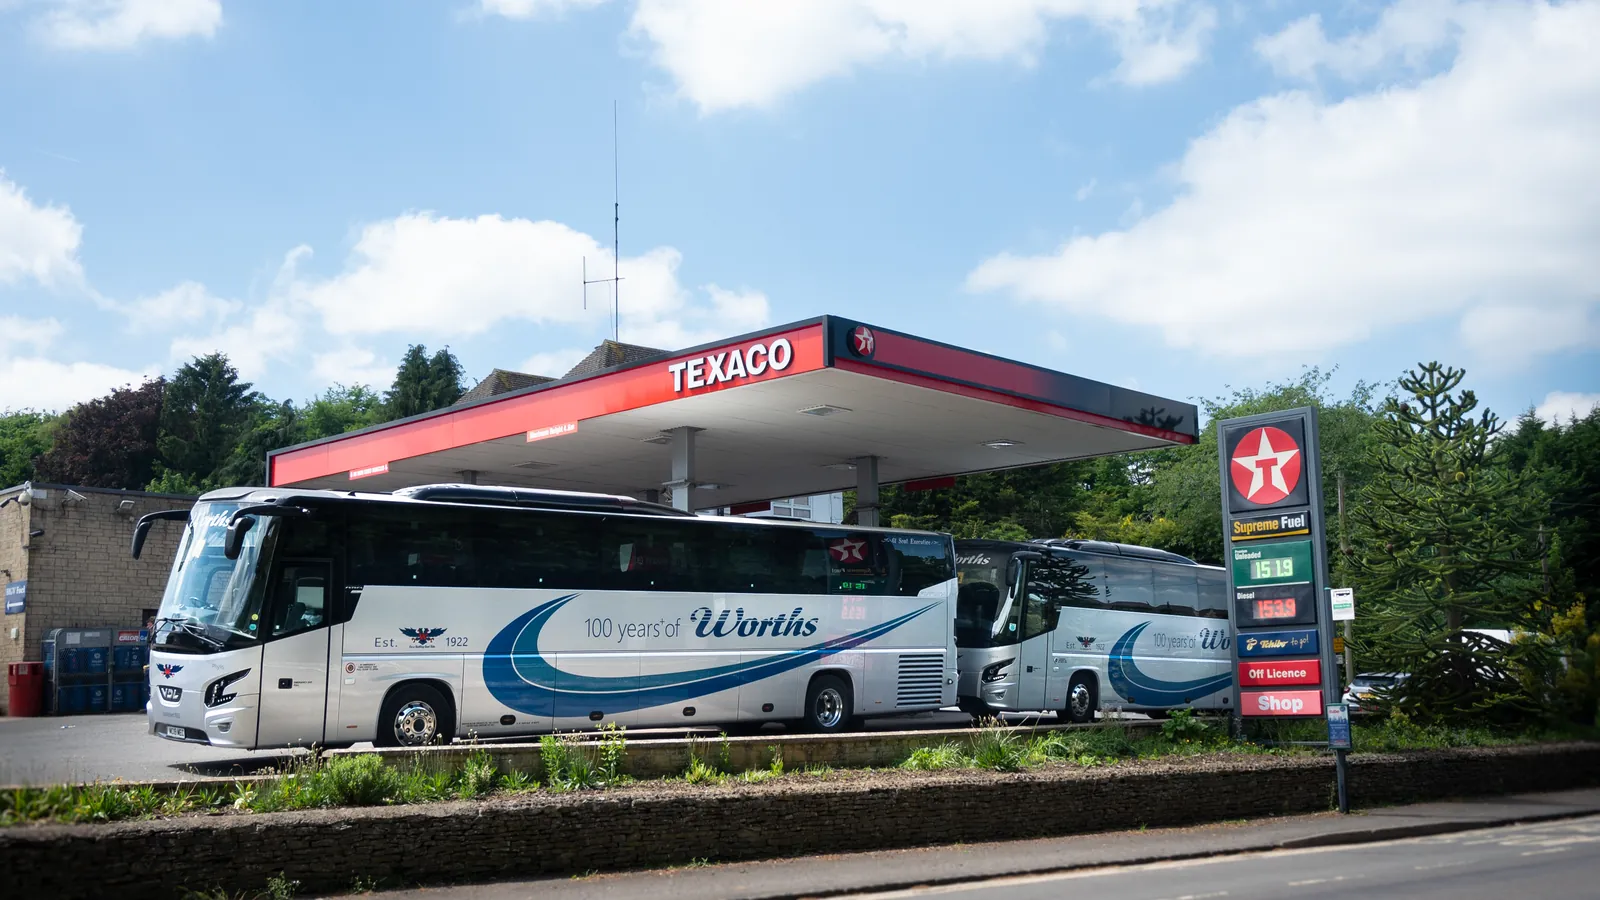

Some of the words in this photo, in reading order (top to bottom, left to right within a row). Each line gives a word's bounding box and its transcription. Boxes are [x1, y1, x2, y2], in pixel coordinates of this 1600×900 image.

[668, 338, 792, 392] TEXACO
[1234, 520, 1279, 534] Supreme
[1281, 514, 1305, 529] Fuel
[956, 553, 991, 565] orths
[1235, 551, 1261, 560] Unleaded
[1237, 592, 1255, 600] Diesel
[585, 617, 612, 637] 100
[665, 617, 681, 637] of
[690, 607, 819, 638] Worths
[375, 637, 398, 647] Est.
[446, 637, 468, 647] 1922
[1153, 633, 1166, 647] 100
[1189, 635, 1196, 648] of
[1260, 640, 1289, 648] Tchibo
[1291, 637, 1298, 646] to
[1249, 668, 1264, 679] Off
[1267, 669, 1306, 679] Licence
[161, 687, 179, 699] VDL
[1258, 695, 1303, 713] Shop
